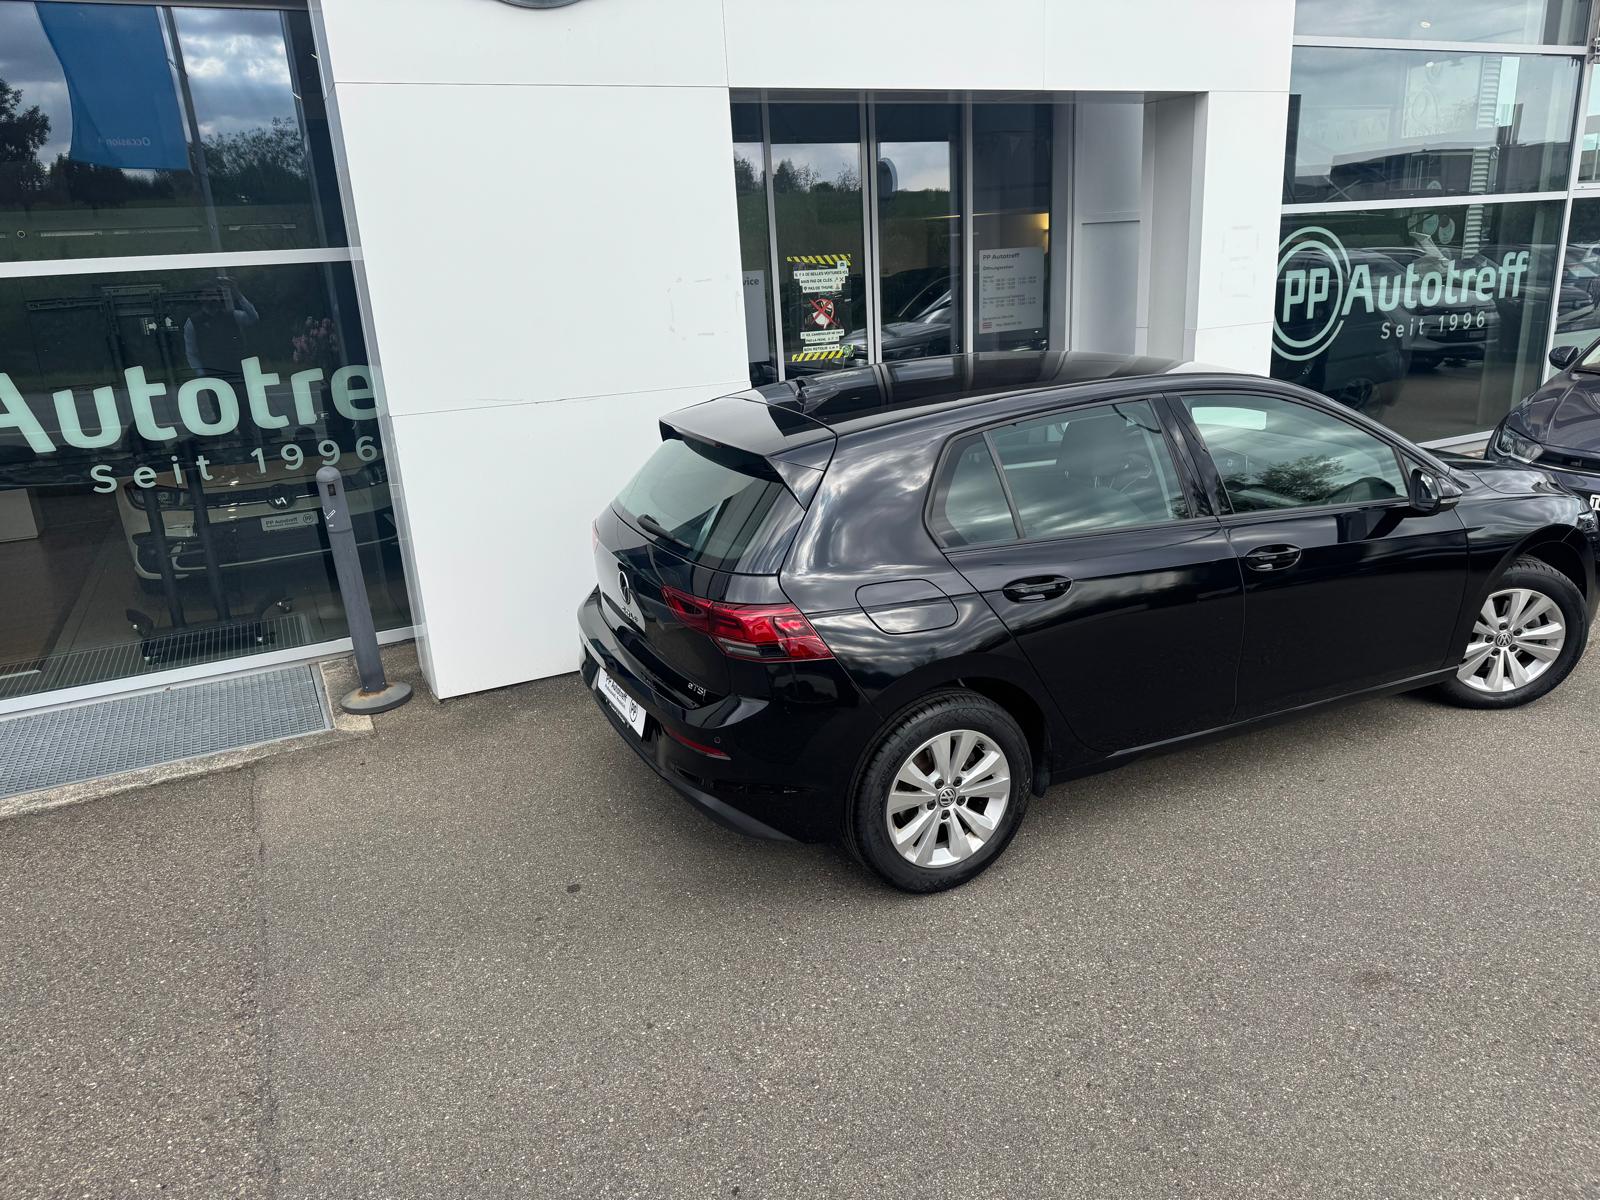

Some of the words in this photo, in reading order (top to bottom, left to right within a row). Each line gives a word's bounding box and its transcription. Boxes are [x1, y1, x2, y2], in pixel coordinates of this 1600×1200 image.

[992, 252, 1021, 260] Autotreff
[1282, 267, 1331, 323] PP
[1340, 250, 1530, 316] Autotreff
[1379, 316, 1426, 340] Seit
[1438, 310, 1486, 333] 1996
[89, 455, 214, 494] Seit
[250, 435, 378, 475] 1996
[687, 682, 707, 697] eTSI
